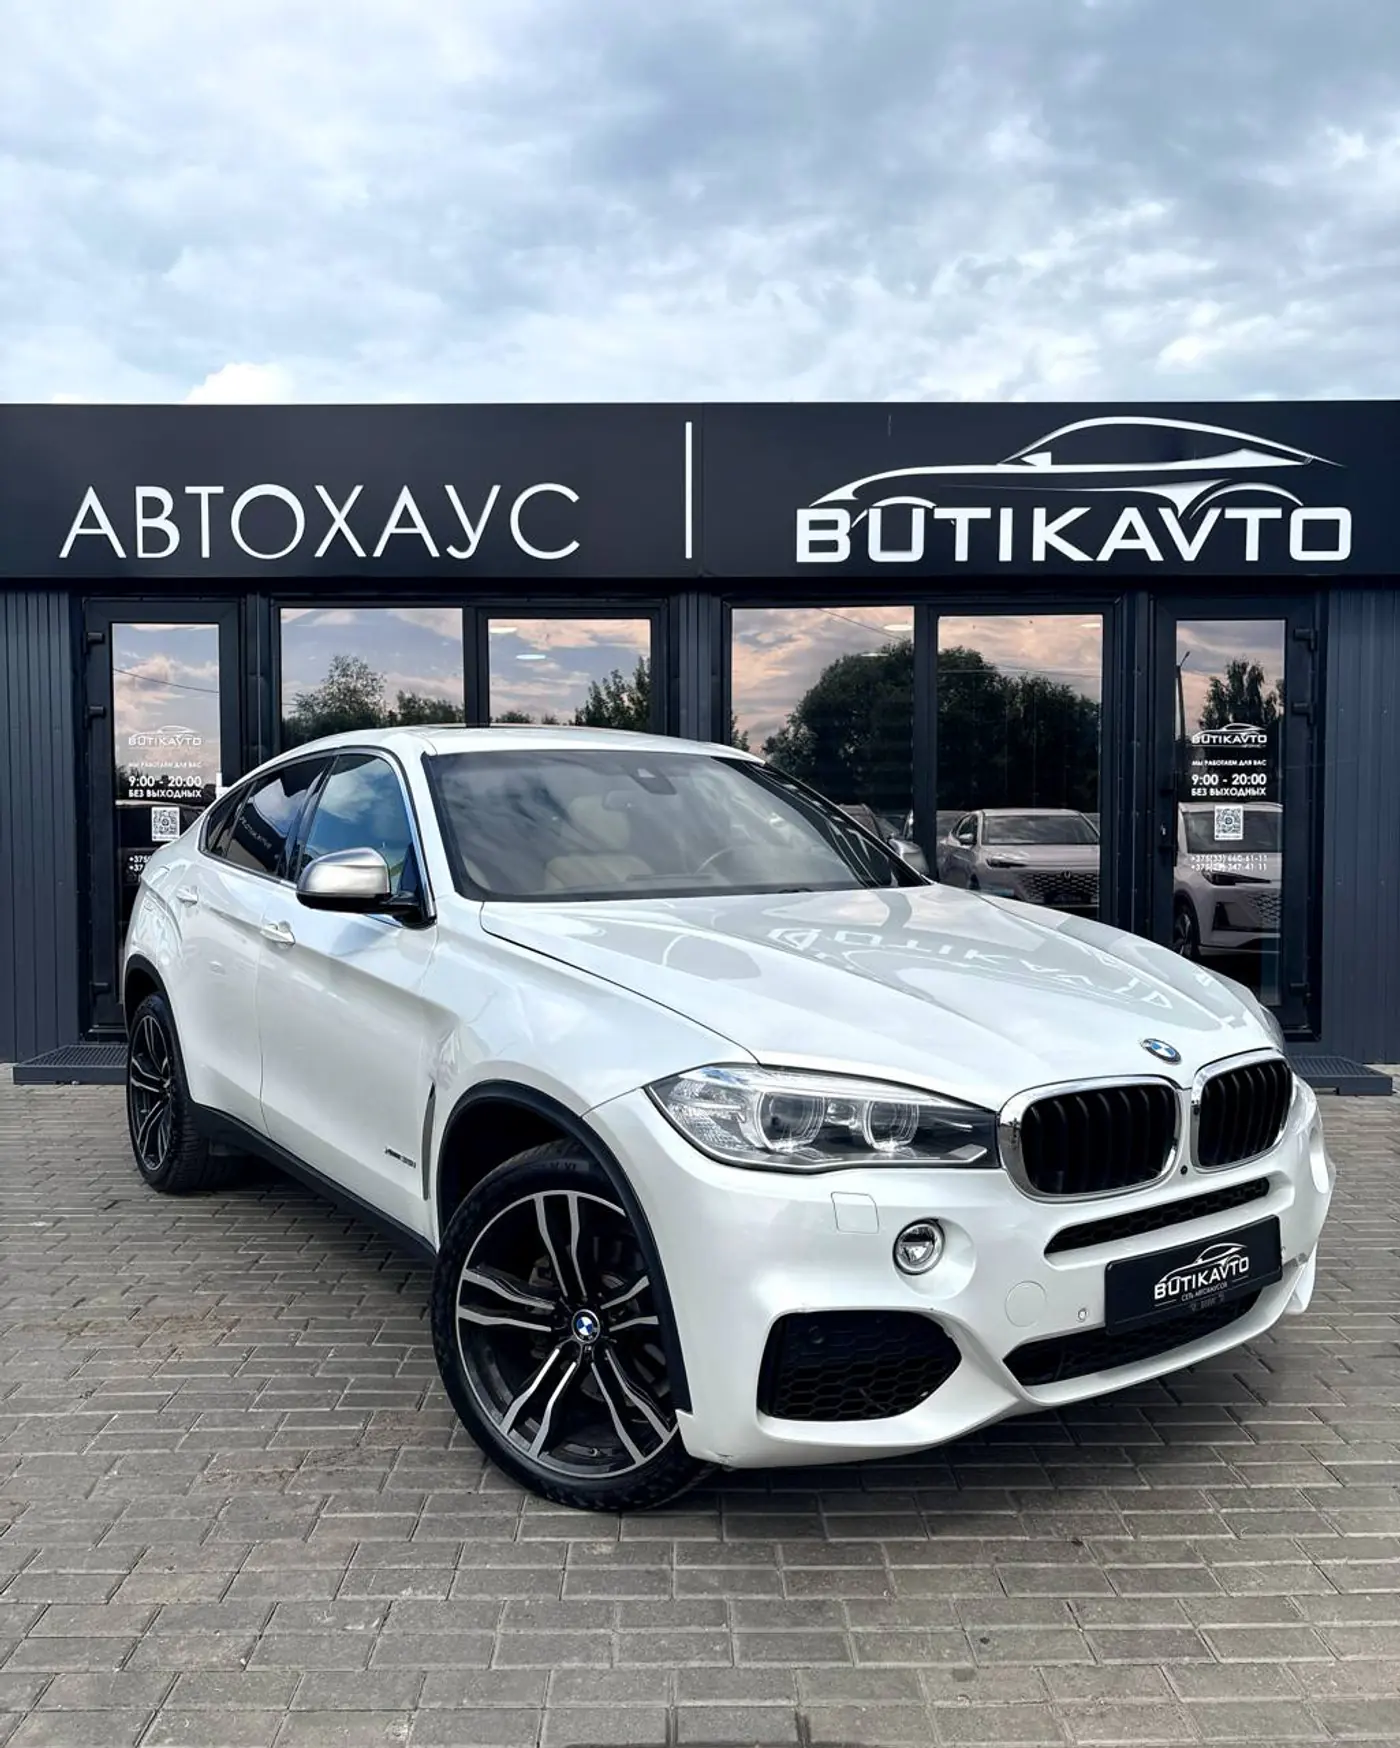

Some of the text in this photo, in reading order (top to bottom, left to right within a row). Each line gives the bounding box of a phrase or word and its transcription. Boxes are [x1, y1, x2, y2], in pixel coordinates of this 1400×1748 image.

[60, 483, 580, 560] АВТОХАУС
[796, 506, 1352, 563] BUTIKAVTO
[128, 736, 202, 746] BUTIKAVTO
[1191, 734, 1268, 744] BUTIKAVTO
[1191, 759, 1267, 767] МЫ РАБОТАЕМ ДЛЯ ВАС
[128, 776, 155, 787] 9:00
[168, 776, 202, 787] 20:00
[1191, 773, 1219, 786] 9:00
[1231, 773, 1267, 786] 20:00
[128, 789, 202, 798] БЕЗ ВЫХОДНЫХ
[1191, 787, 1266, 797] БЕЗ ВЫХОДНЫХ
[1154, 1257, 1249, 1300] BUTIKAVTO
